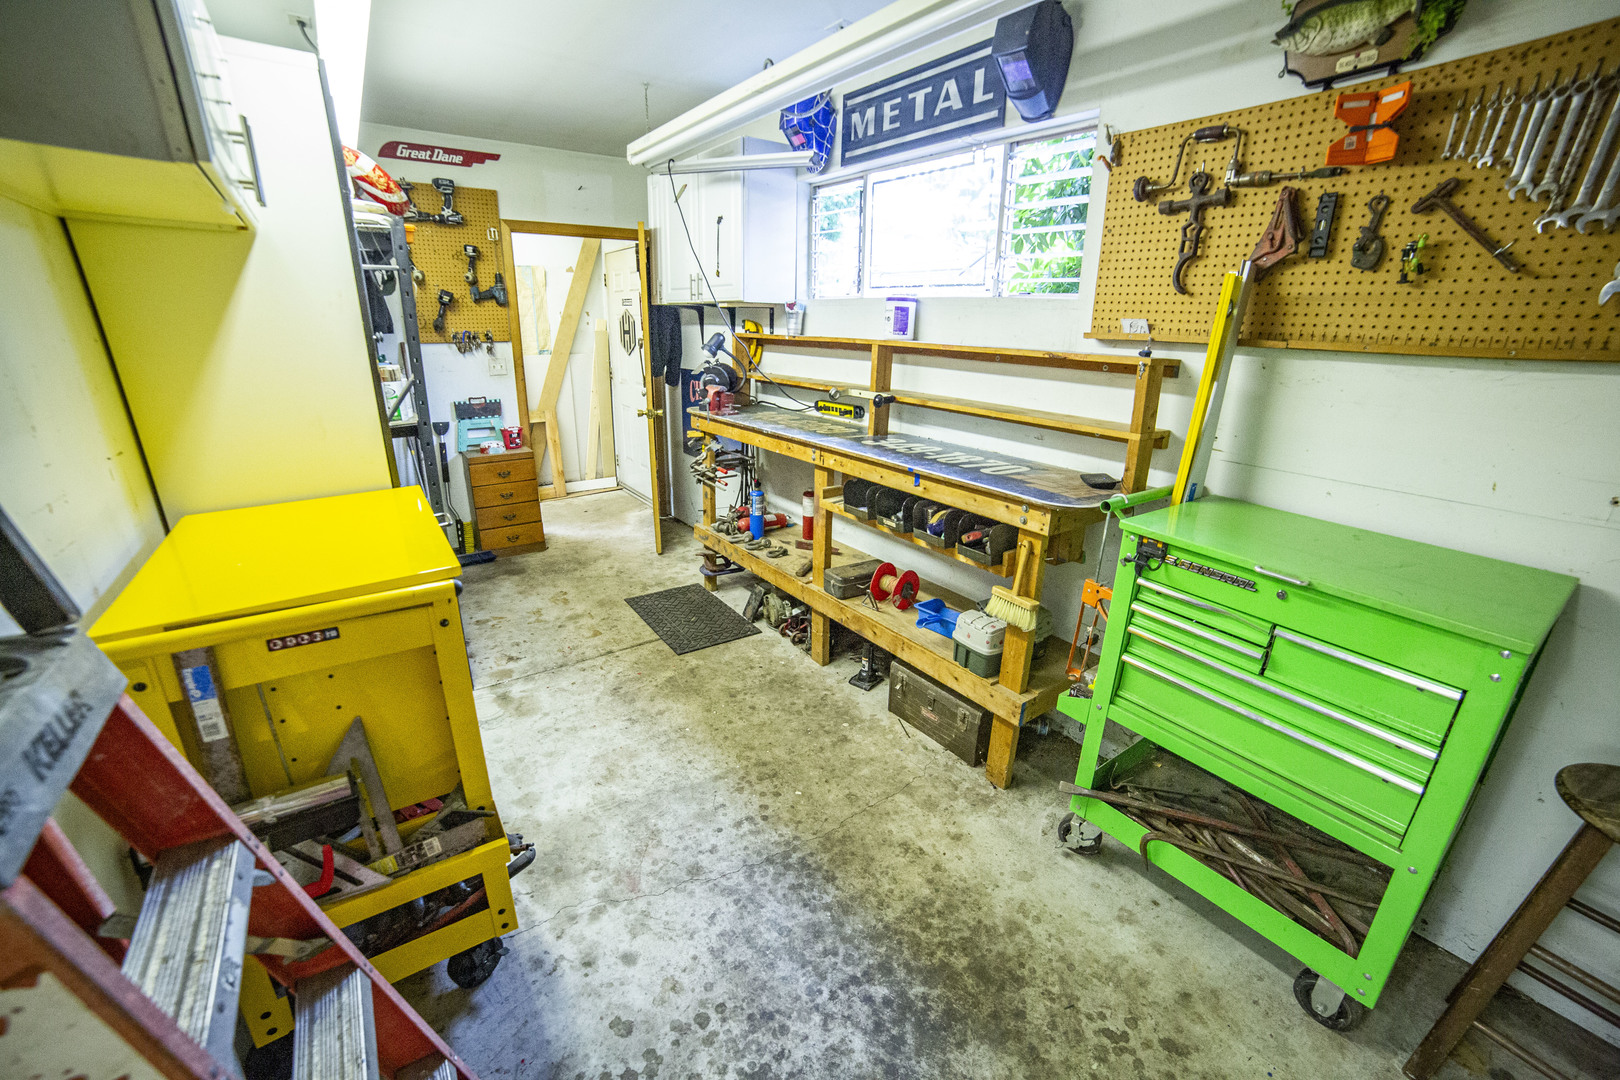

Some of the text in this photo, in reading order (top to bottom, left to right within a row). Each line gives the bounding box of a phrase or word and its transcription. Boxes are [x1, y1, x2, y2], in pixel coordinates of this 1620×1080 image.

[851, 67, 994, 141] METAL
[396, 144, 463, 164] Great Dane
